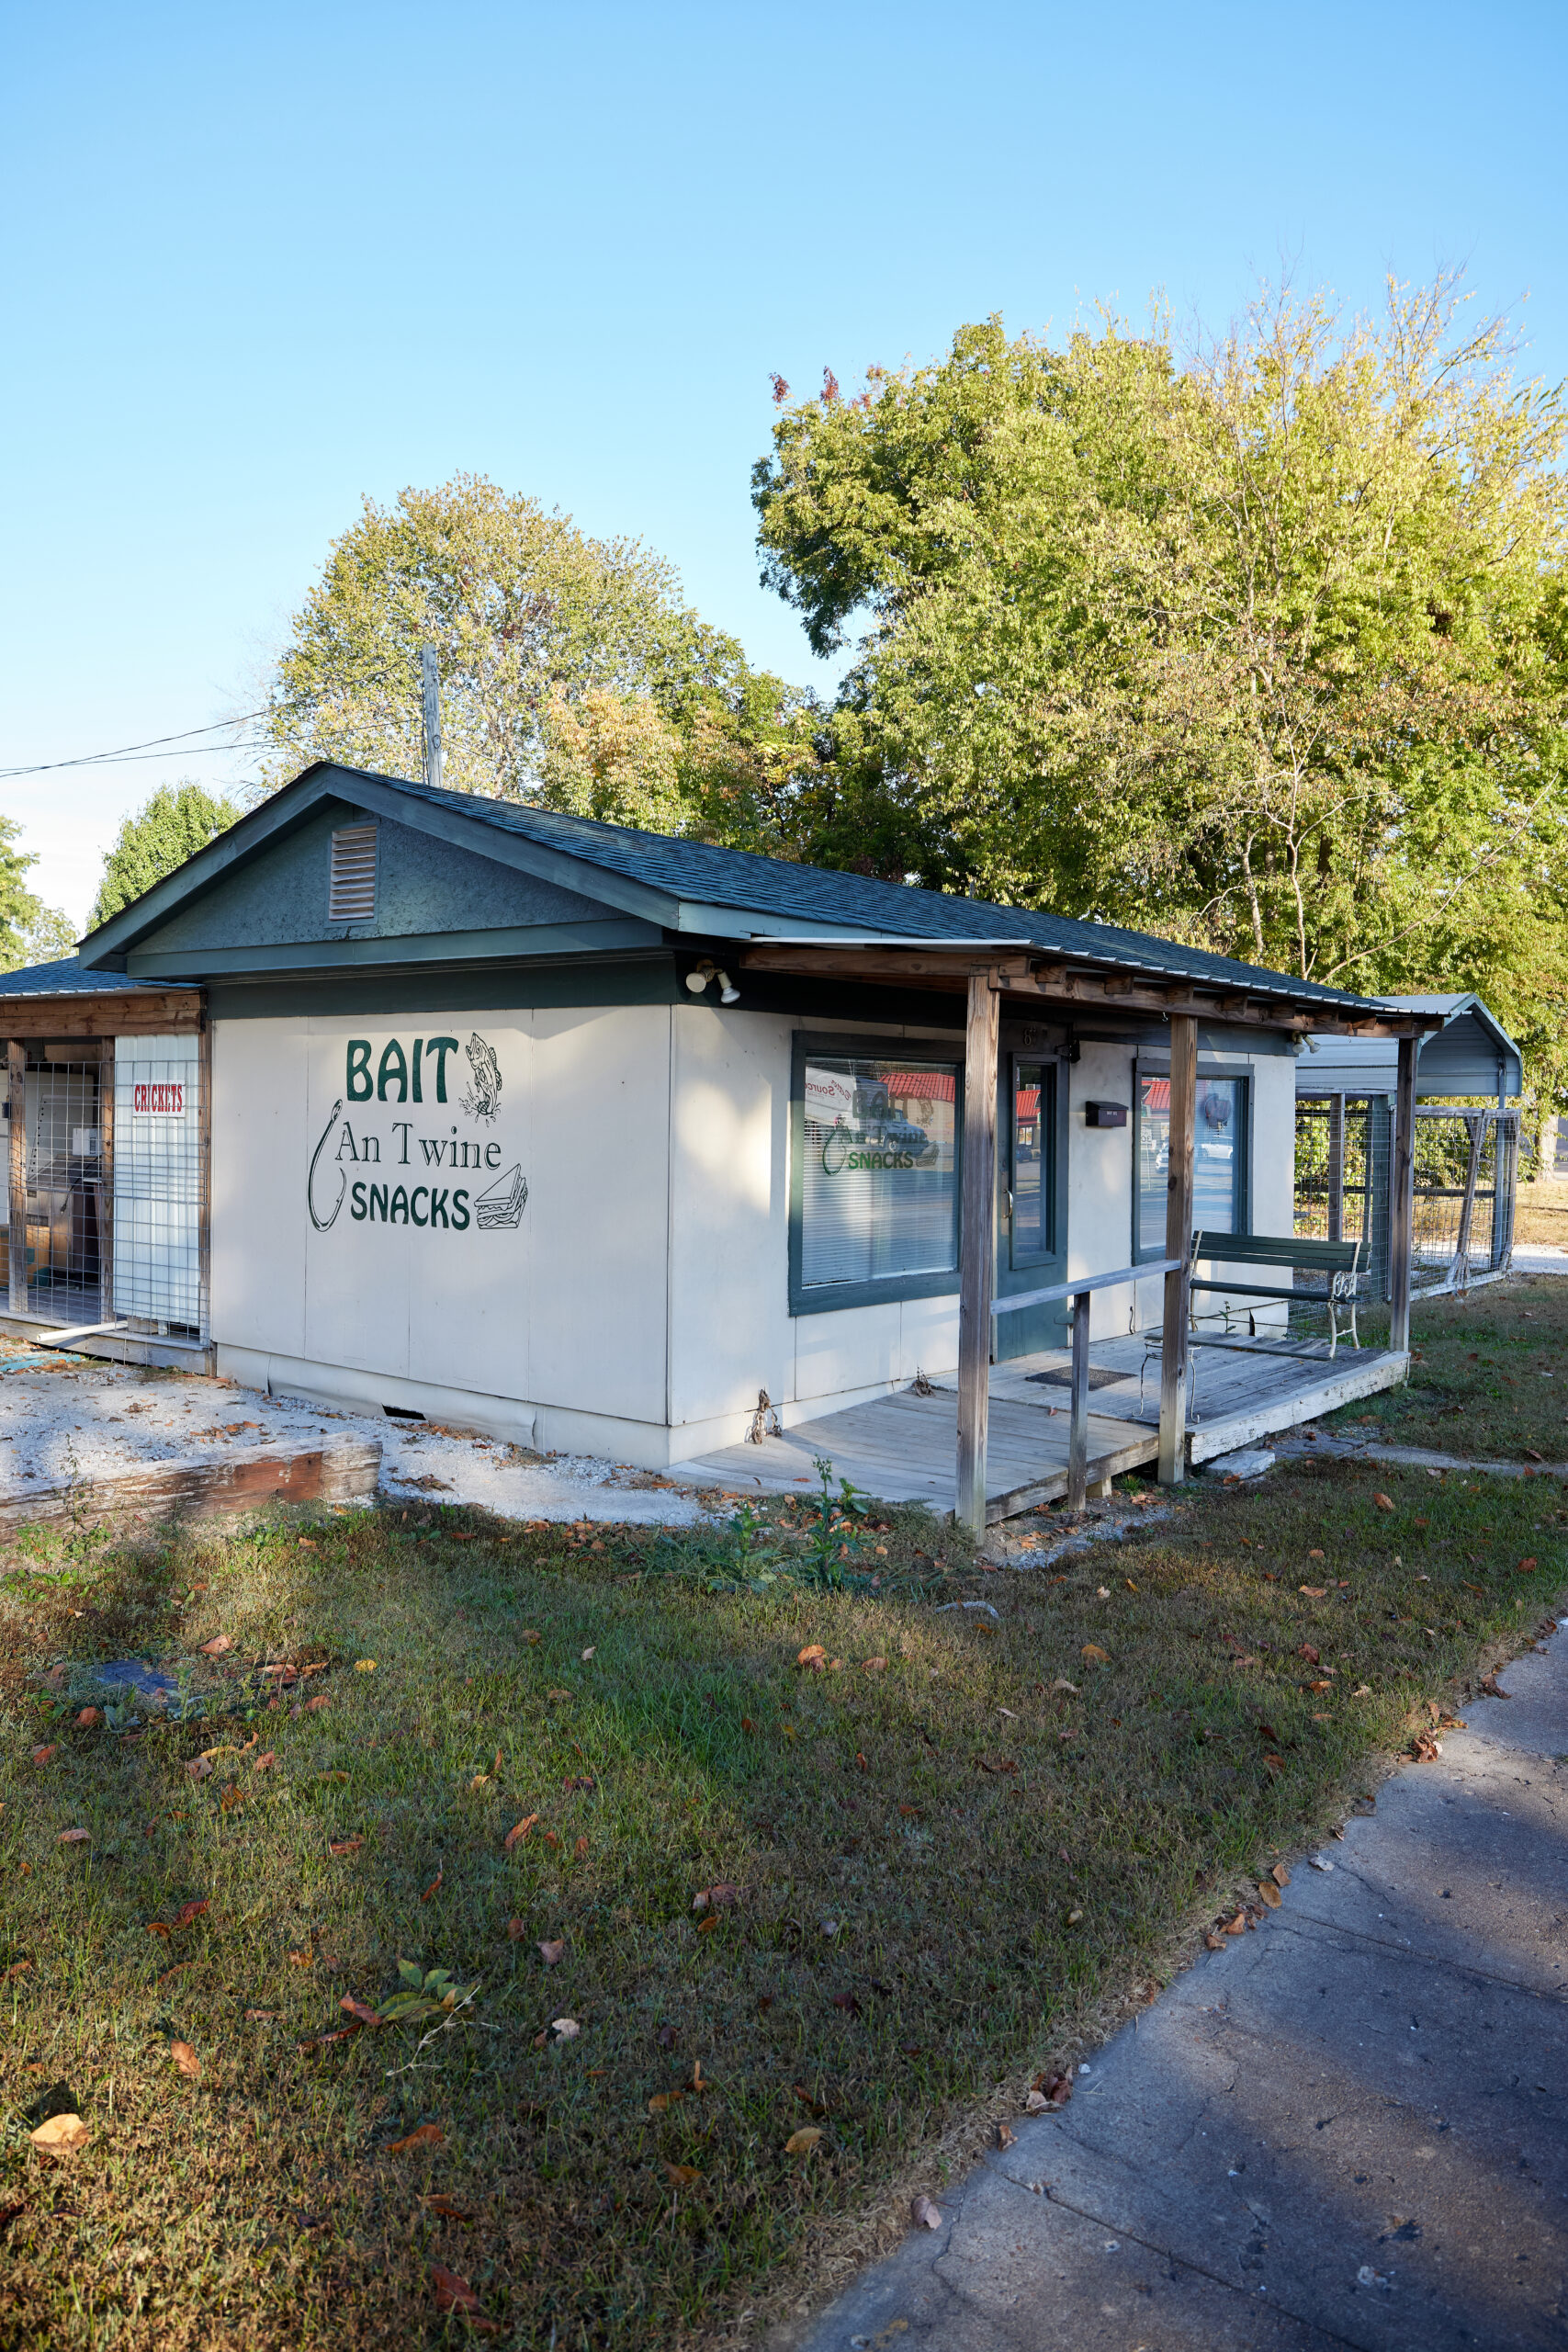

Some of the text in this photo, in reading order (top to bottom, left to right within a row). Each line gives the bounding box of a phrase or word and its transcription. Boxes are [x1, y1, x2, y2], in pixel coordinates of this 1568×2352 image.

[346, 1036, 459, 1103] BAIT
[134, 1083, 183, 1113] CRICKETS
[852, 1089, 915, 1118] BAIT
[335, 1121, 502, 1170] An Twine
[848, 1151, 914, 1170] SNACKS
[351, 1181, 470, 1231] SNACKS
